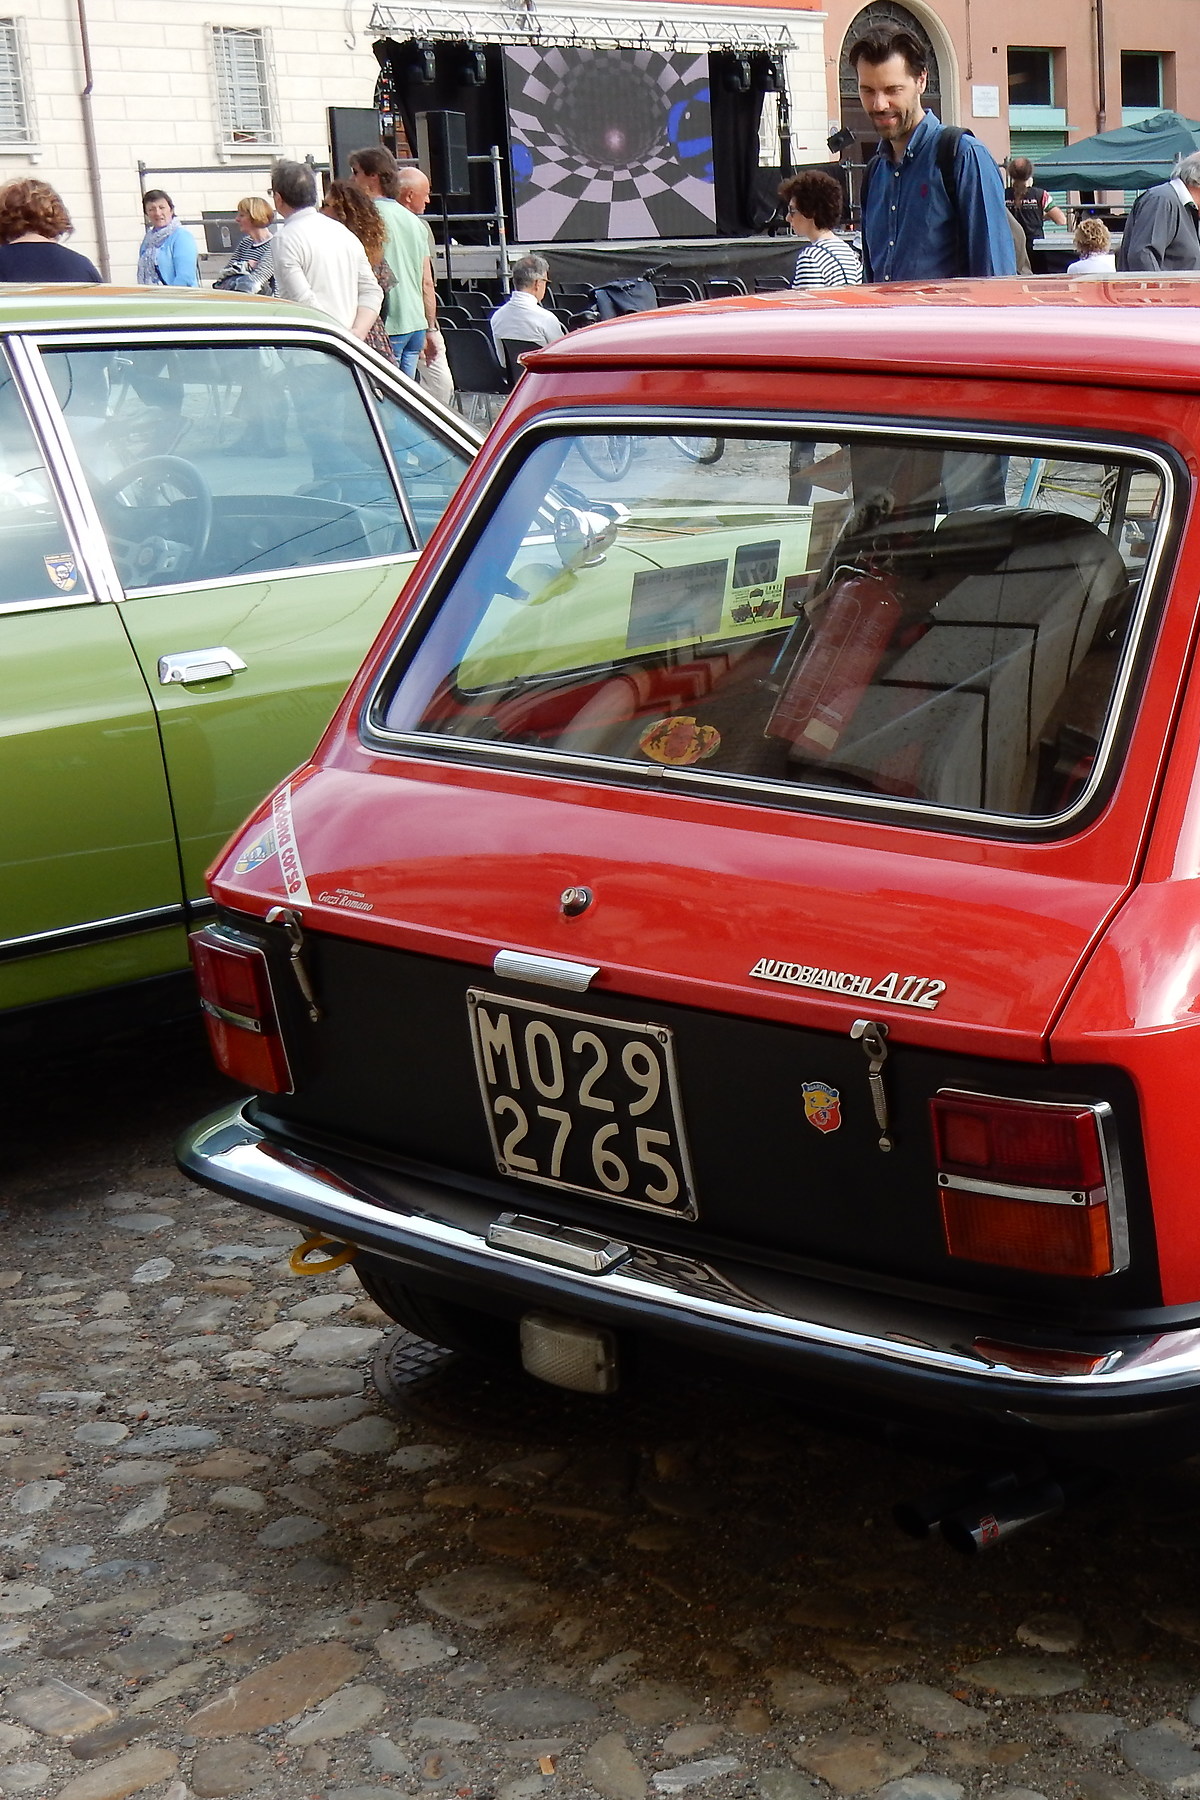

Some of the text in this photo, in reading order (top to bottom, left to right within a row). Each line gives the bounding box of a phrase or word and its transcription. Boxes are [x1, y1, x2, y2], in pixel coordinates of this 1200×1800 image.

[273, 791, 303, 894] modena corse
[340, 895, 374, 912] Romano
[749, 957, 947, 1010] AUTOBIANCHI A112
[494, 1095, 679, 1204] 2765
